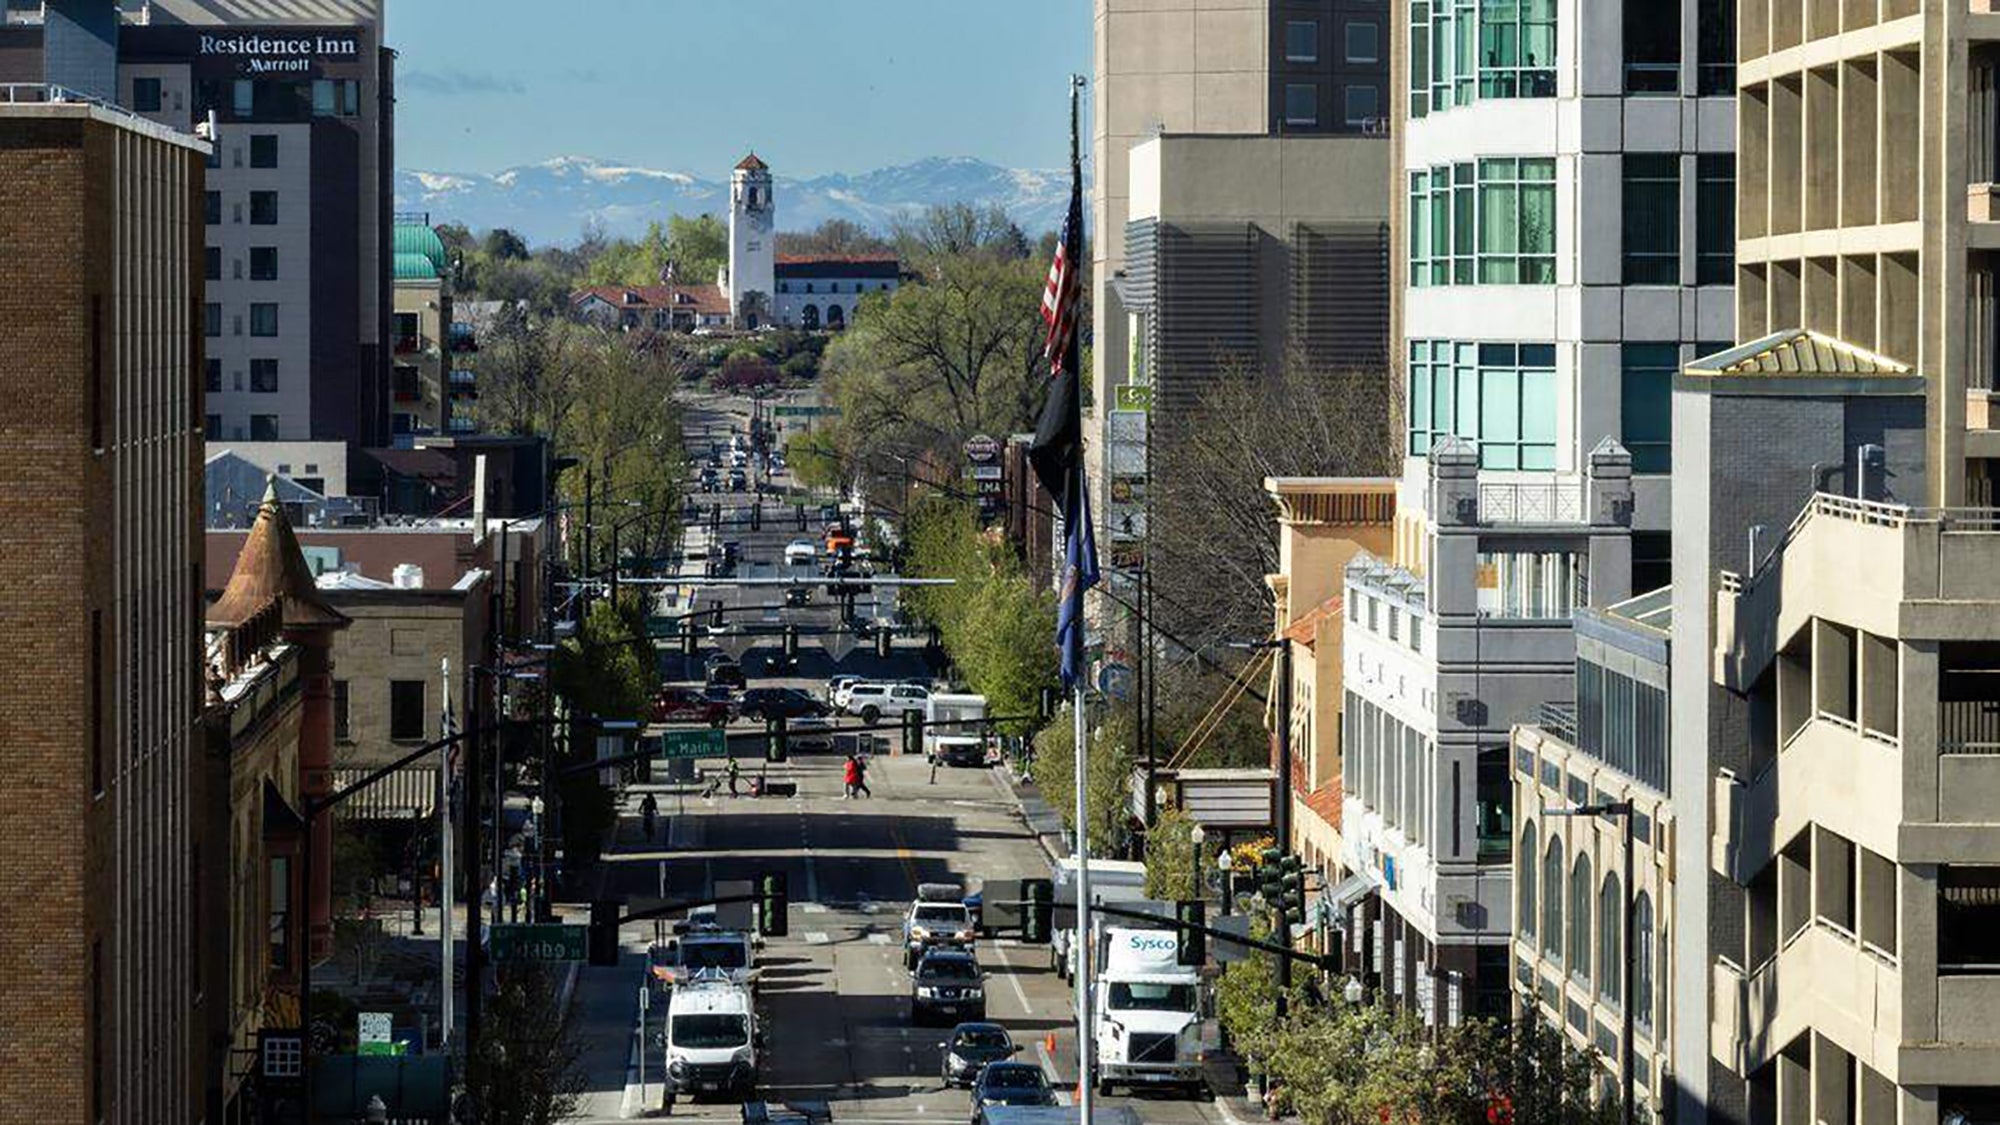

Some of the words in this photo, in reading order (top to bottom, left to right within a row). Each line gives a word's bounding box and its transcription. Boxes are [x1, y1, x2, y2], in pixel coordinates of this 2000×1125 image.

[200, 36, 311, 54] Residence
[316, 36, 355, 54] Inn
[246, 58, 309, 72] Marriott
[679, 742, 710, 754] Main
[1131, 936, 1176, 951] Sysco
